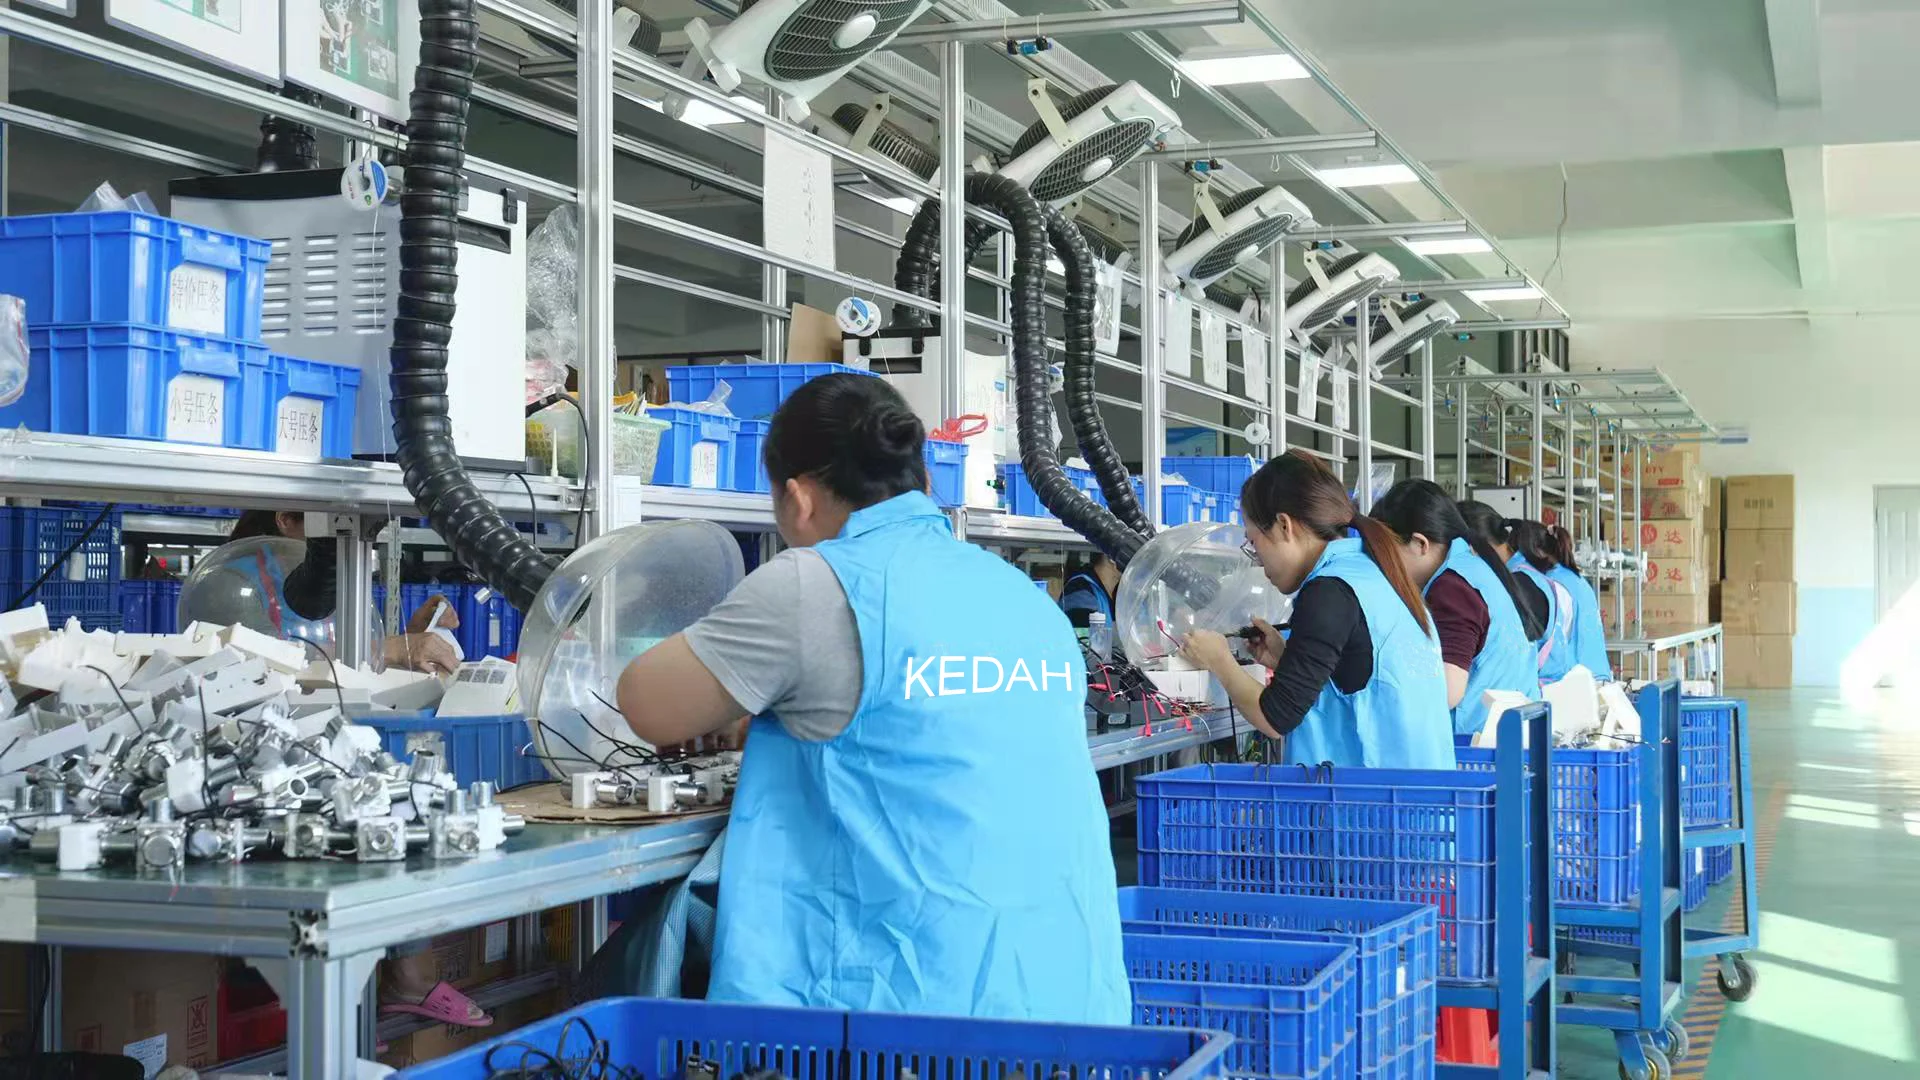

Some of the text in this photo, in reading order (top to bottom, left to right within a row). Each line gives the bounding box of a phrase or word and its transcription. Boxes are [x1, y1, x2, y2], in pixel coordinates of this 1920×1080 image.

[170, 387, 218, 427] 小号压条
[279, 408, 318, 444] 大号压条
[904, 655, 1073, 700] KEDAH
